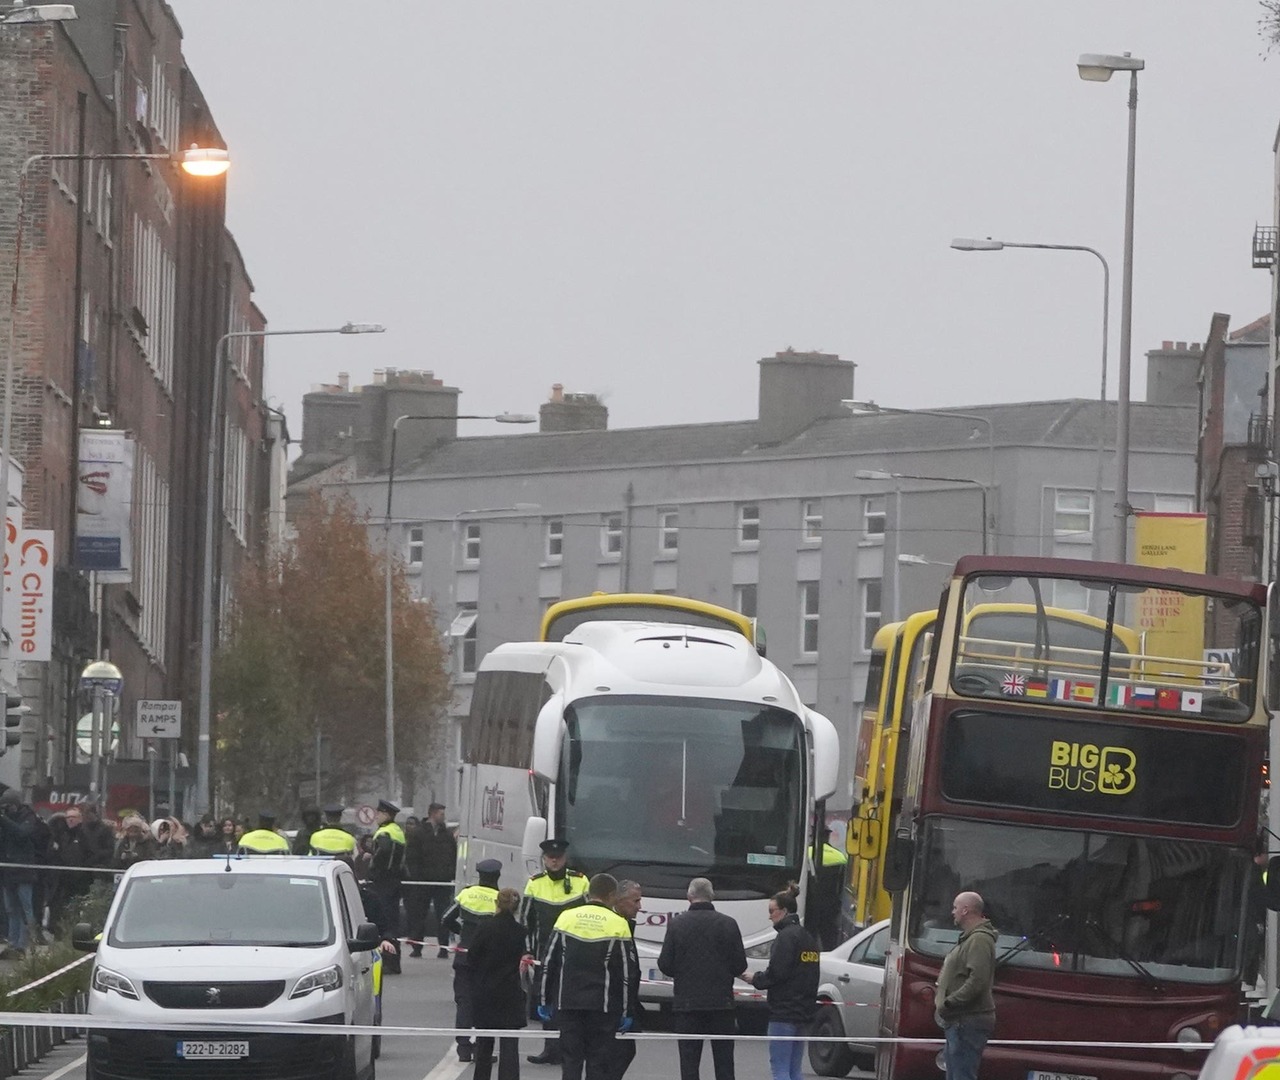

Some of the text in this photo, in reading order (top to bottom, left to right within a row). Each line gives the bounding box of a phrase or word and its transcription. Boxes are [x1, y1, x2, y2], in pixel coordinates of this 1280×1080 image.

[21, 572, 44, 653] chime
[1140, 607, 1181, 617] TIMES
[1140, 618, 1167, 627] OUT
[141, 714, 177, 724] RAMPS
[1051, 740, 1099, 768] BIG
[1048, 766, 1096, 793] BUS
[575, 912, 608, 922] GARDA
[185, 1044, 246, 1056] 222-D-21282
